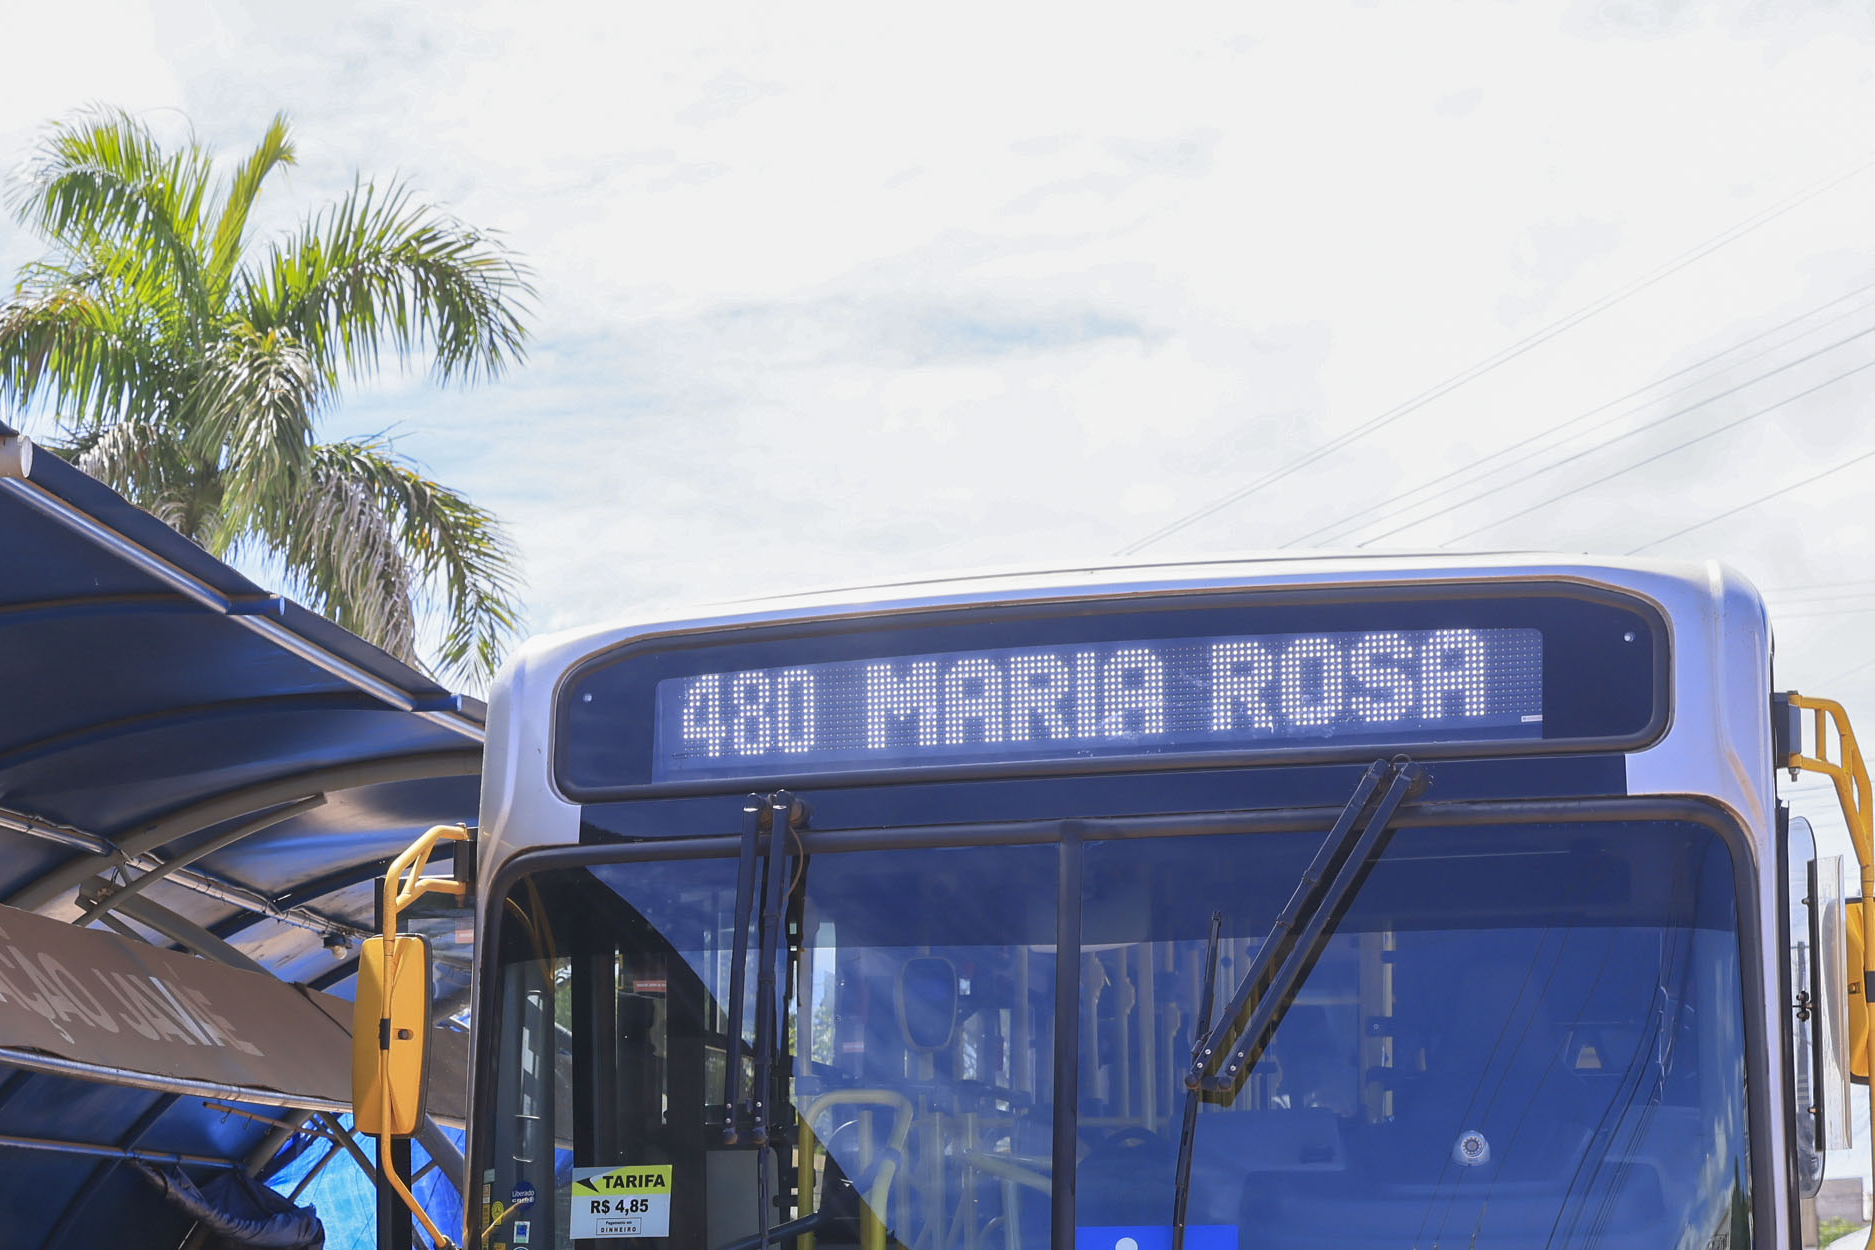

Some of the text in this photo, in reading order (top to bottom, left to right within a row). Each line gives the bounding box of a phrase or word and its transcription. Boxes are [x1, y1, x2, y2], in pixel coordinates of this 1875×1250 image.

[682, 628, 1485, 757] 480 MARIA ROSA
[602, 1174, 666, 1189] TARIFA
[590, 1198, 649, 1216] R$ 4,85
